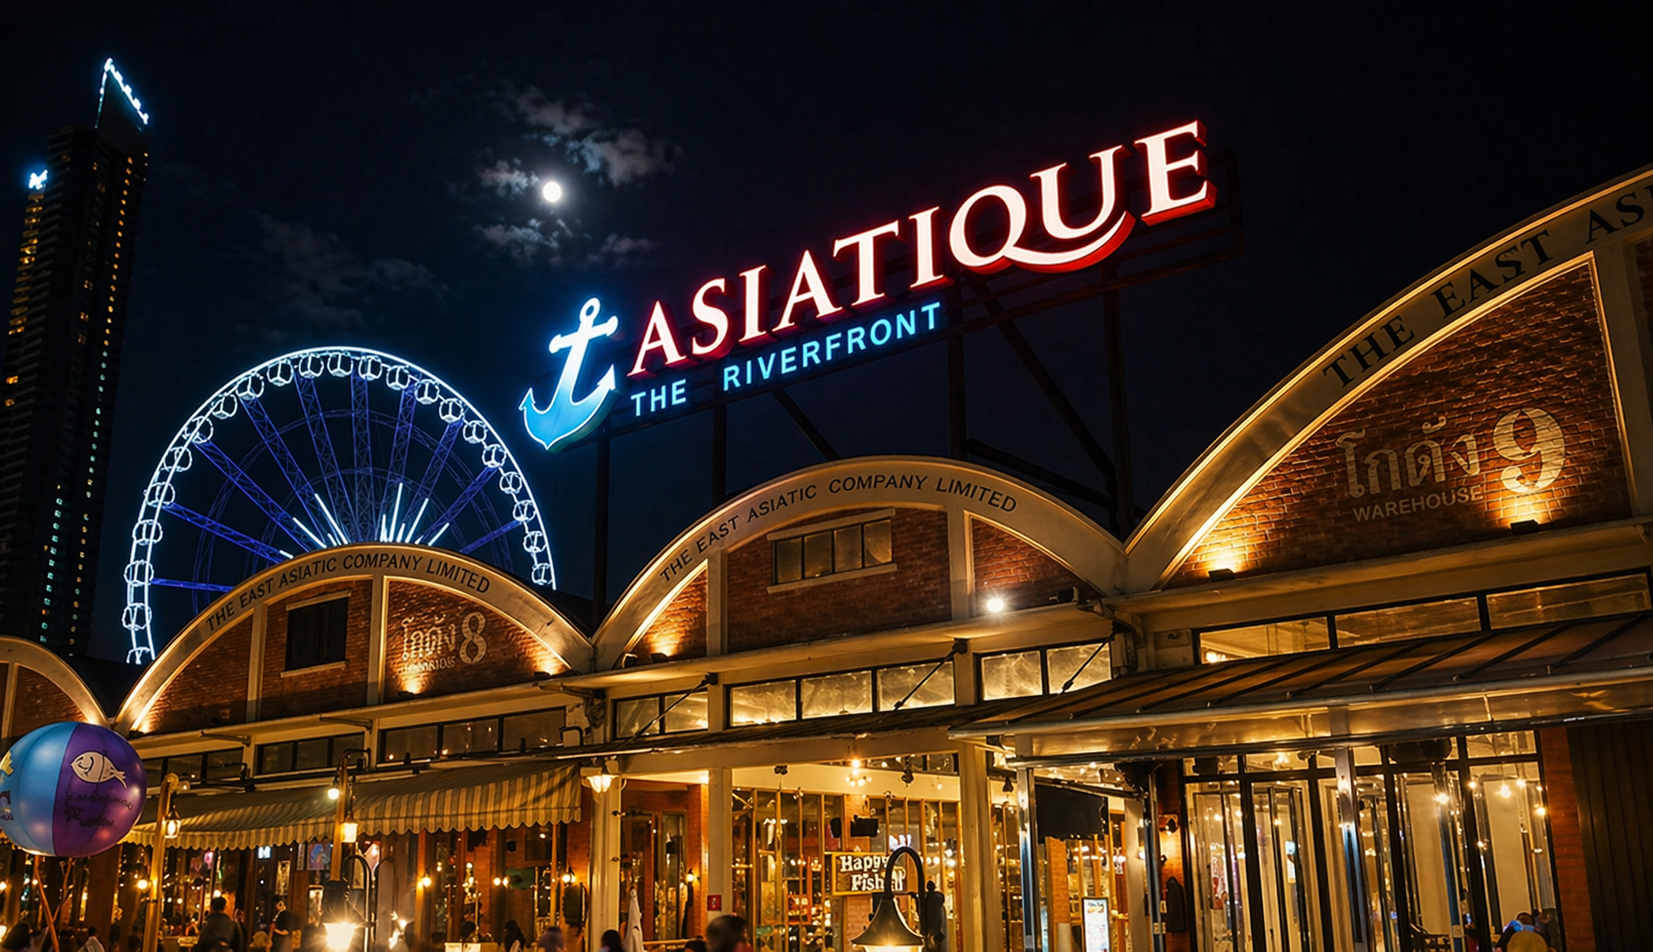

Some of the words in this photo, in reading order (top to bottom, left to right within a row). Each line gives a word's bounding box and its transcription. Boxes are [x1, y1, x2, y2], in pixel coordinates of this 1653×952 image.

[628, 119, 1216, 379] ASIATIQUE
[1323, 315, 1415, 388] THE
[1430, 229, 1554, 318] EAST
[630, 378, 688, 418] THE
[723, 302, 942, 393] RIVERFRONT
[1335, 415, 1481, 498] โกดัง
[1493, 407, 1566, 494] 9
[659, 549, 693, 582] THE
[696, 515, 739, 554] EAST
[747, 484, 818, 523] ASIATIC
[828, 474, 929, 494] COMPANY
[935, 476, 1017, 513] LIMITED
[1353, 483, 1485, 523] WAREHOUSE
[206, 601, 235, 632] THE
[239, 578, 274, 608] EAST
[278, 557, 337, 588] ASIATIC
[343, 553, 423, 571] COMPANY
[426, 558, 491, 593] LIMITED
[459, 611, 487, 665] 8
